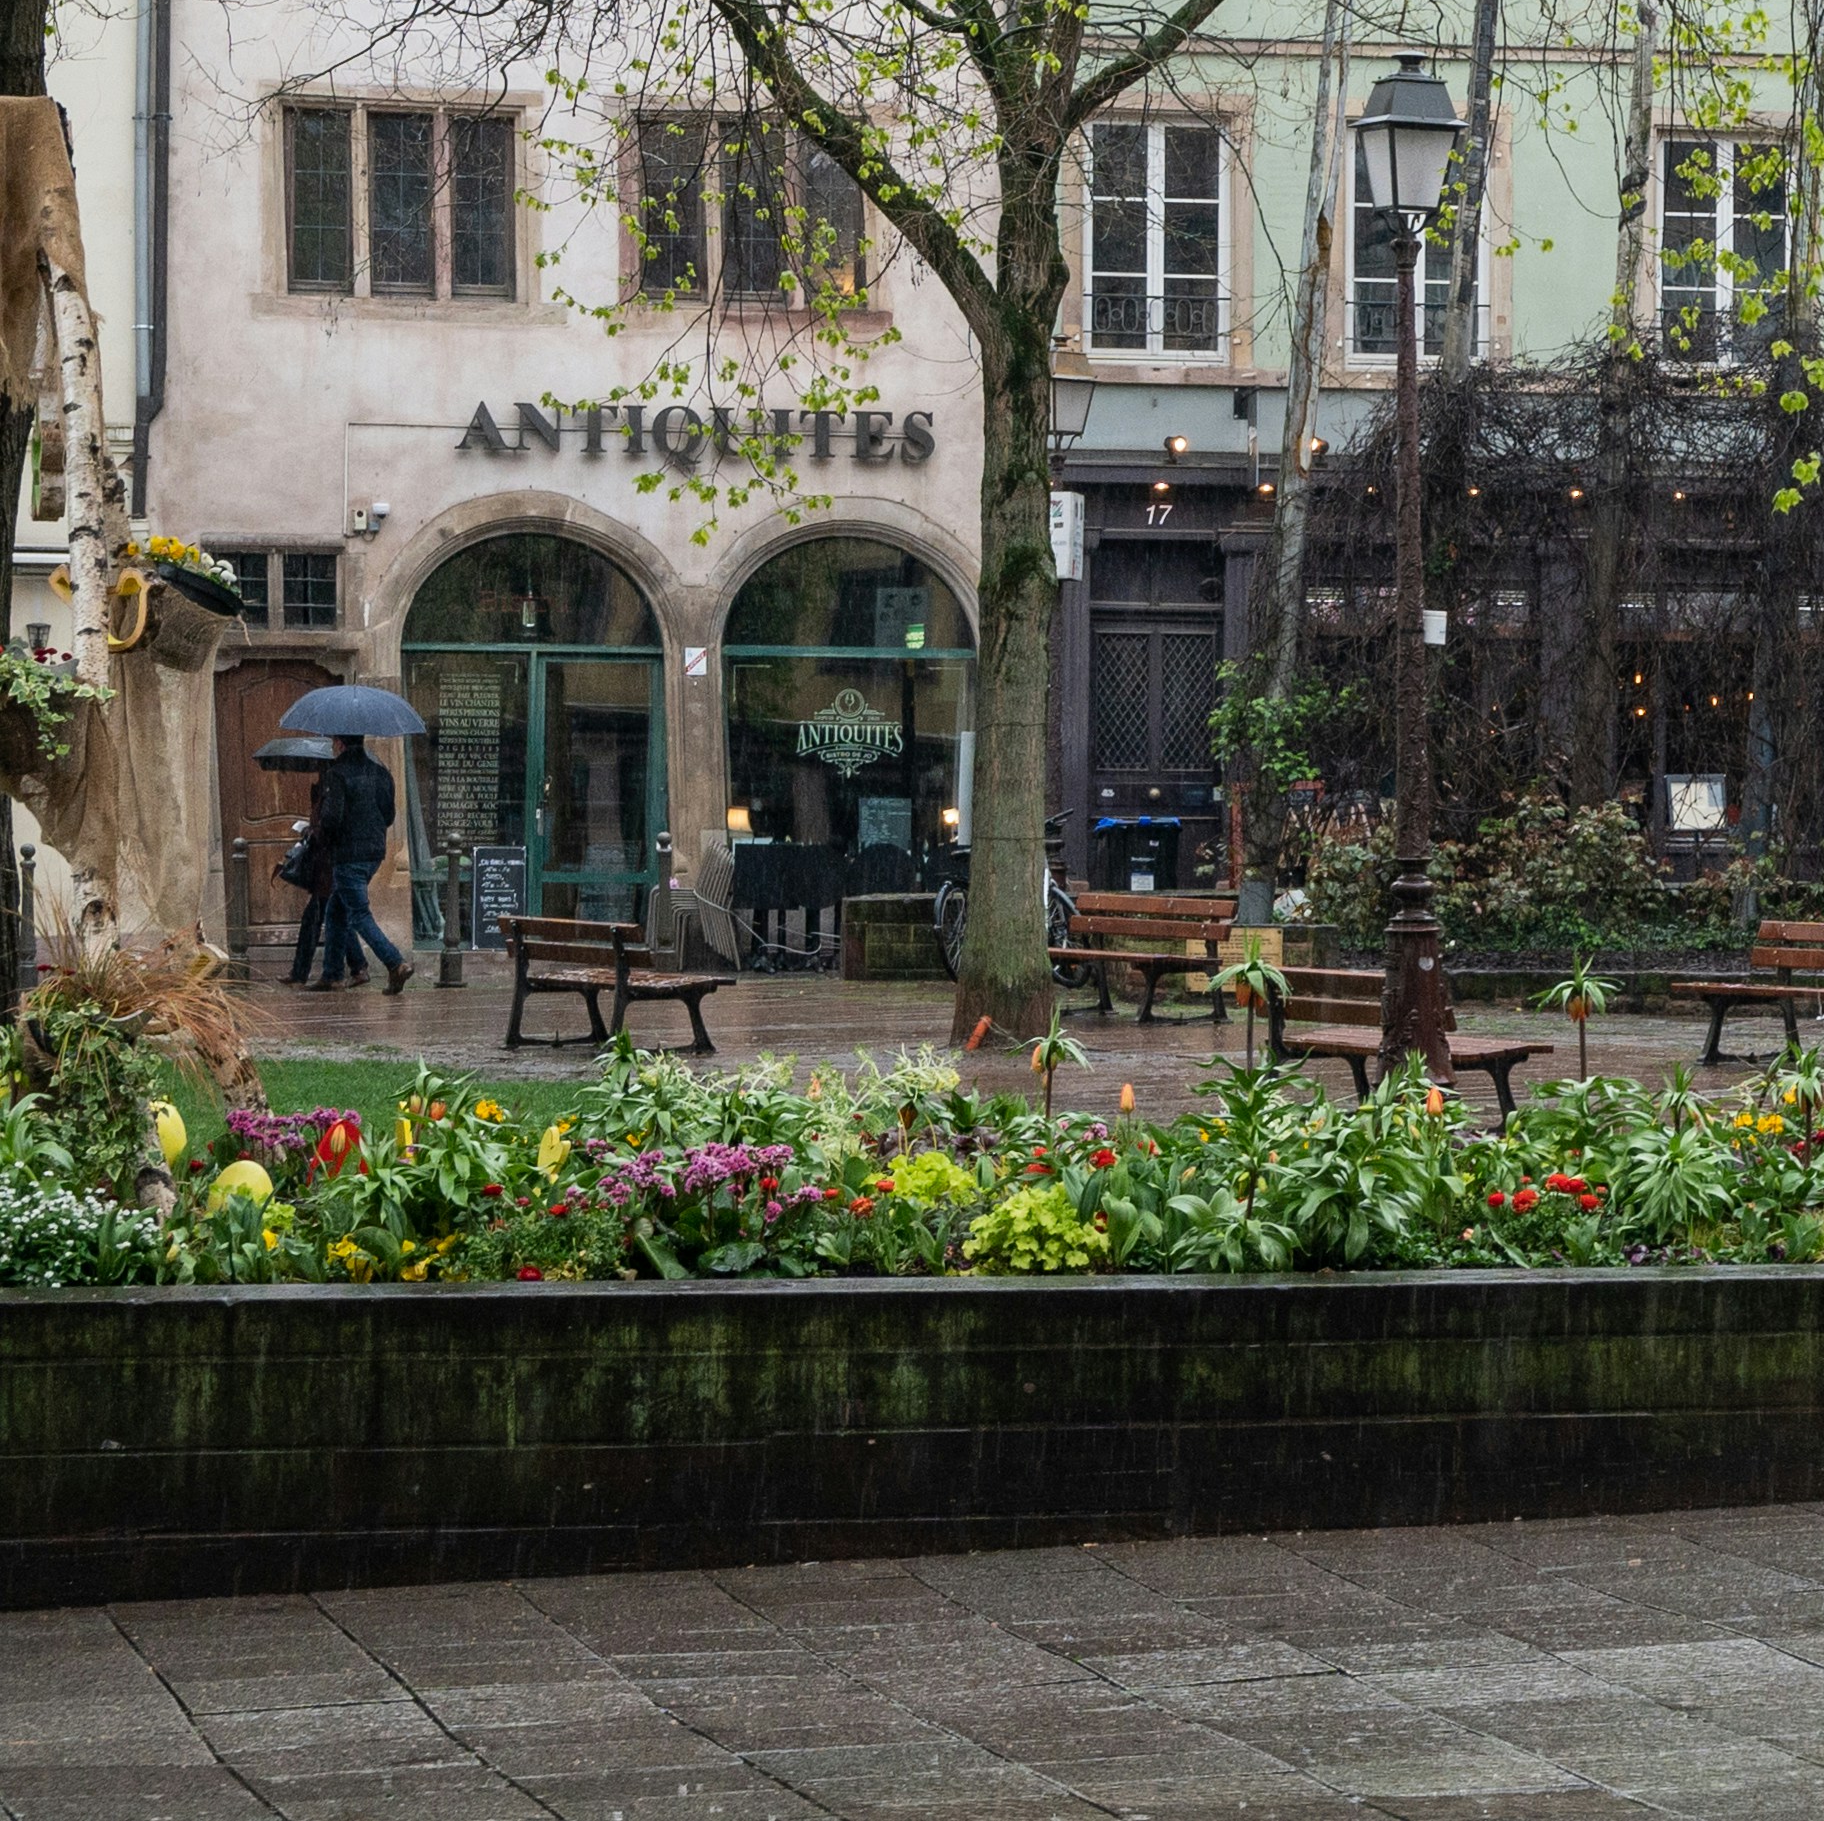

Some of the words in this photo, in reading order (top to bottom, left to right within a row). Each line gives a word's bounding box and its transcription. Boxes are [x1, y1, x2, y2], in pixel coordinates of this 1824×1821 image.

[454, 399, 936, 464] ANTIQUITES
[1146, 504, 1173, 525] 17
[440, 699, 448, 707] LE
[450, 699, 463, 707] VIN
[465, 699, 500, 707] CHANTER
[440, 718, 459, 728] VINS
[460, 718, 471, 728] AU
[472, 718, 500, 728] VERRE
[796, 724, 903, 753] ANTIQUITES
[462, 760, 475, 768] DU
[437, 801, 478, 810] FROMAGES
[481, 801, 499, 810] AOC
